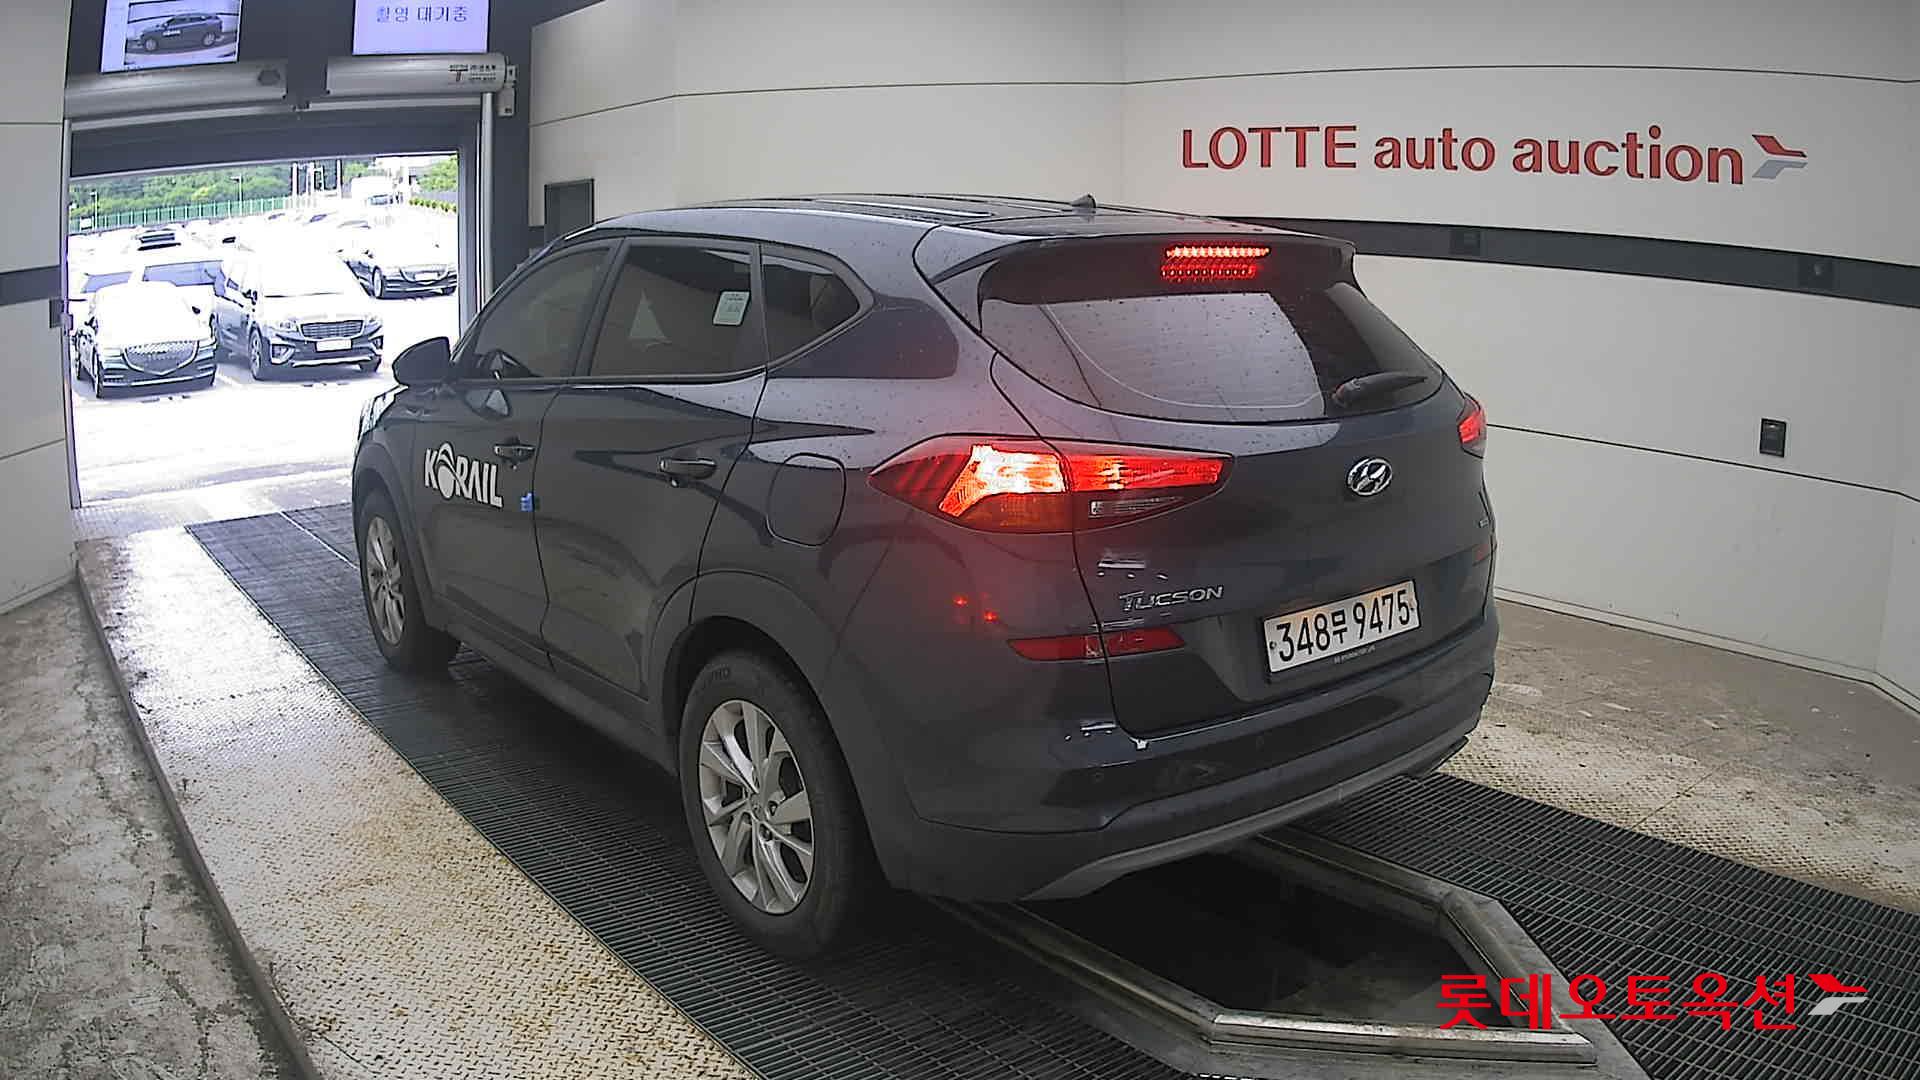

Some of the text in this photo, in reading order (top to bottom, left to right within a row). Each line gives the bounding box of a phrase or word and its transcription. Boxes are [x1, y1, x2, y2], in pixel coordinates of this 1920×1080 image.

[416, 5, 469, 23] 대기중
[1182, 124, 1744, 185] LOTTE auto auction
[424, 441, 504, 508] KORAIL
[1119, 585, 1224, 612] TUCSON
